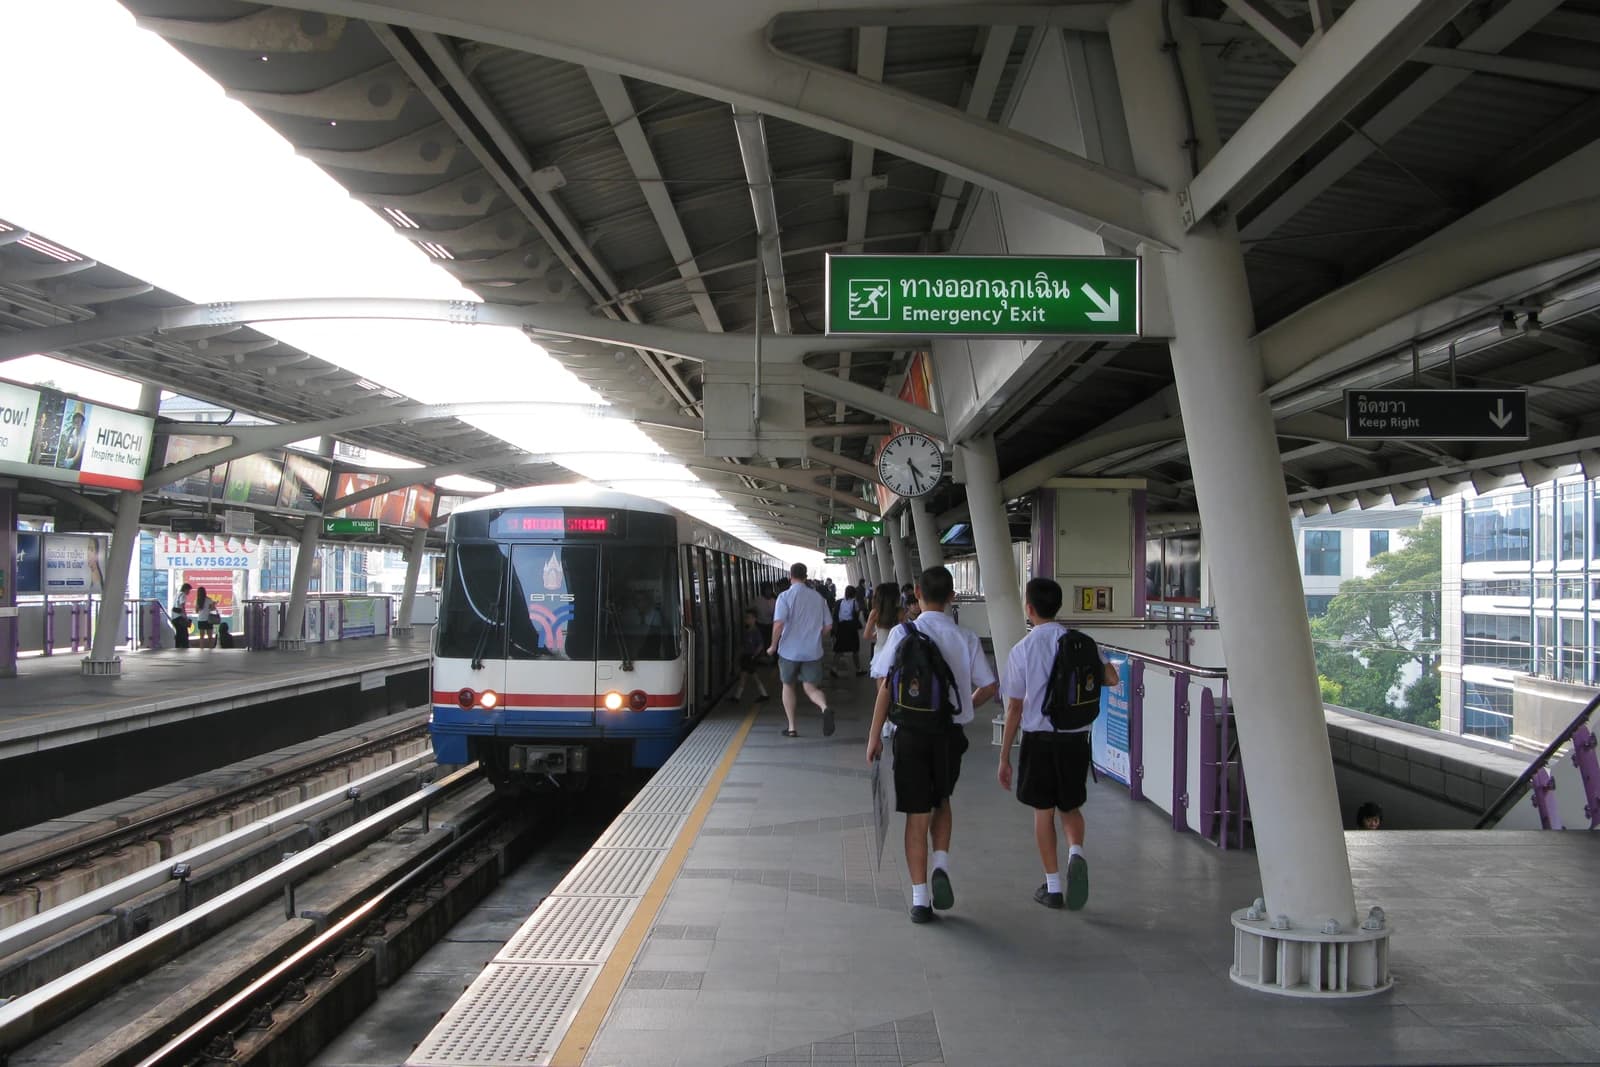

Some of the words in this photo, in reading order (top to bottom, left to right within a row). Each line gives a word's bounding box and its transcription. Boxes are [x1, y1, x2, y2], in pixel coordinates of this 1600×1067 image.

[899, 271, 1070, 309] ทางออกฉุกเฉิน
[903, 306, 1002, 325] Emergency
[1010, 306, 1046, 322] Exit
[1358, 394, 1406, 413] ชิดขวา
[1359, 417, 1387, 429] Keep
[1391, 417, 1420, 429] Right
[96, 427, 143, 452] HITACHI
[91, 447, 114, 462] Inspire
[115, 450, 125, 463] the
[126, 453, 142, 465] Next
[167, 556, 193, 567] TEL.
[195, 556, 249, 567] 6756222
[530, 593, 576, 602] BTS
